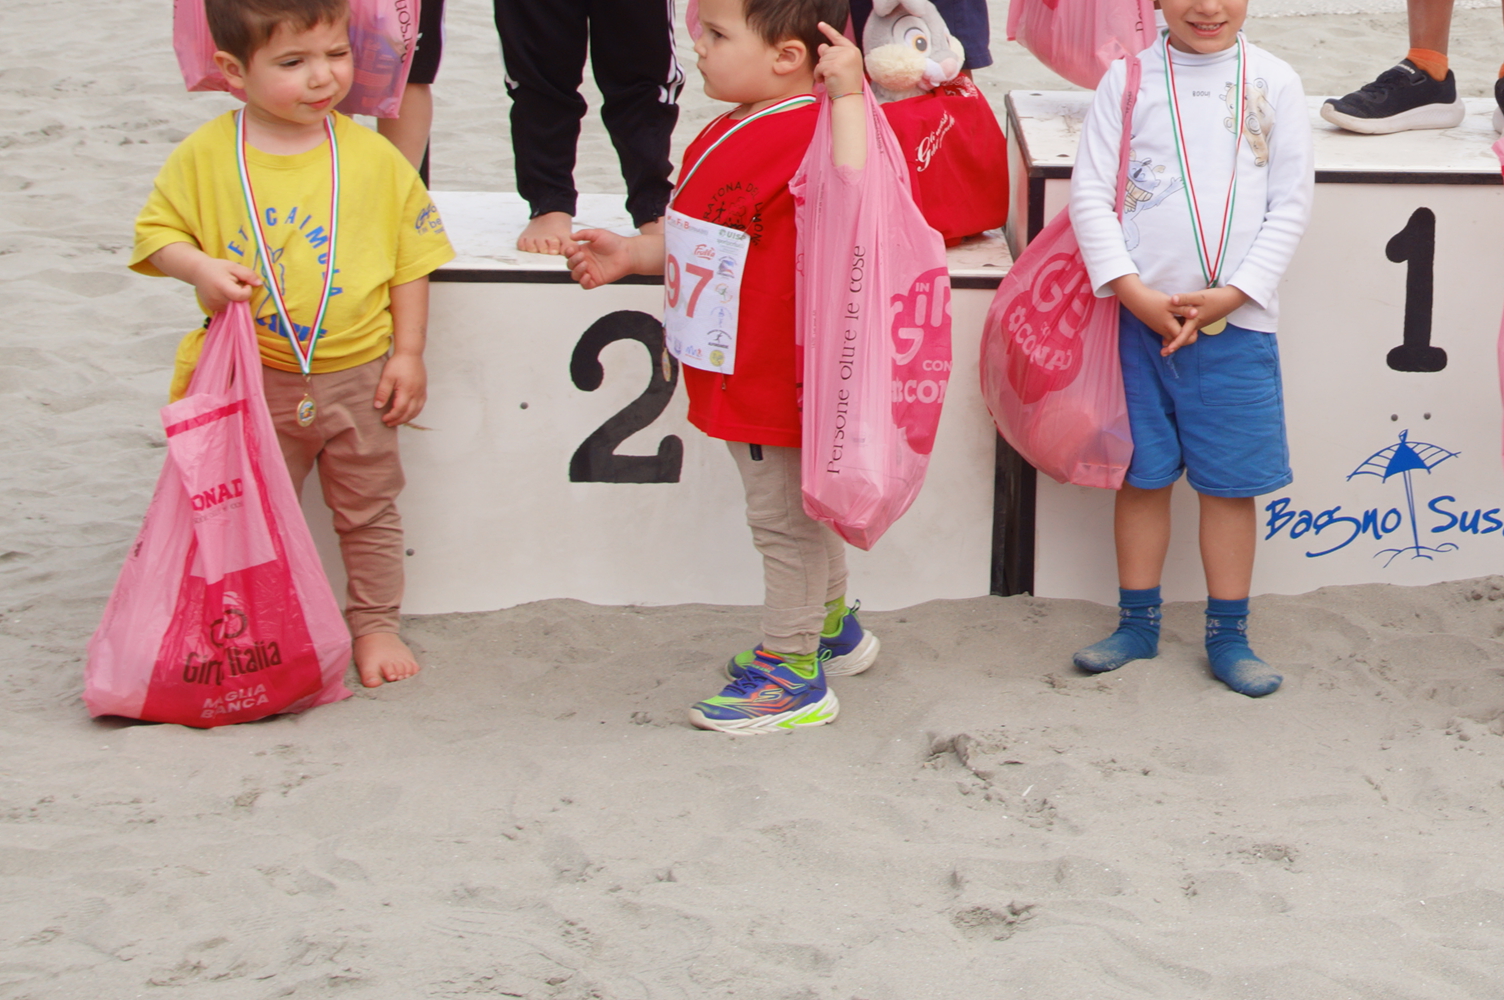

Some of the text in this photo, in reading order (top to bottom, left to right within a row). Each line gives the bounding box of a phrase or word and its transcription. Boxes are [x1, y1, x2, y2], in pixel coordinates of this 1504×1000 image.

[826, 245, 866, 475] cose le oltre Persone
[1385, 206, 1448, 373] 1
[569, 310, 684, 484] 2
[1264, 497, 1402, 558] Bagno
